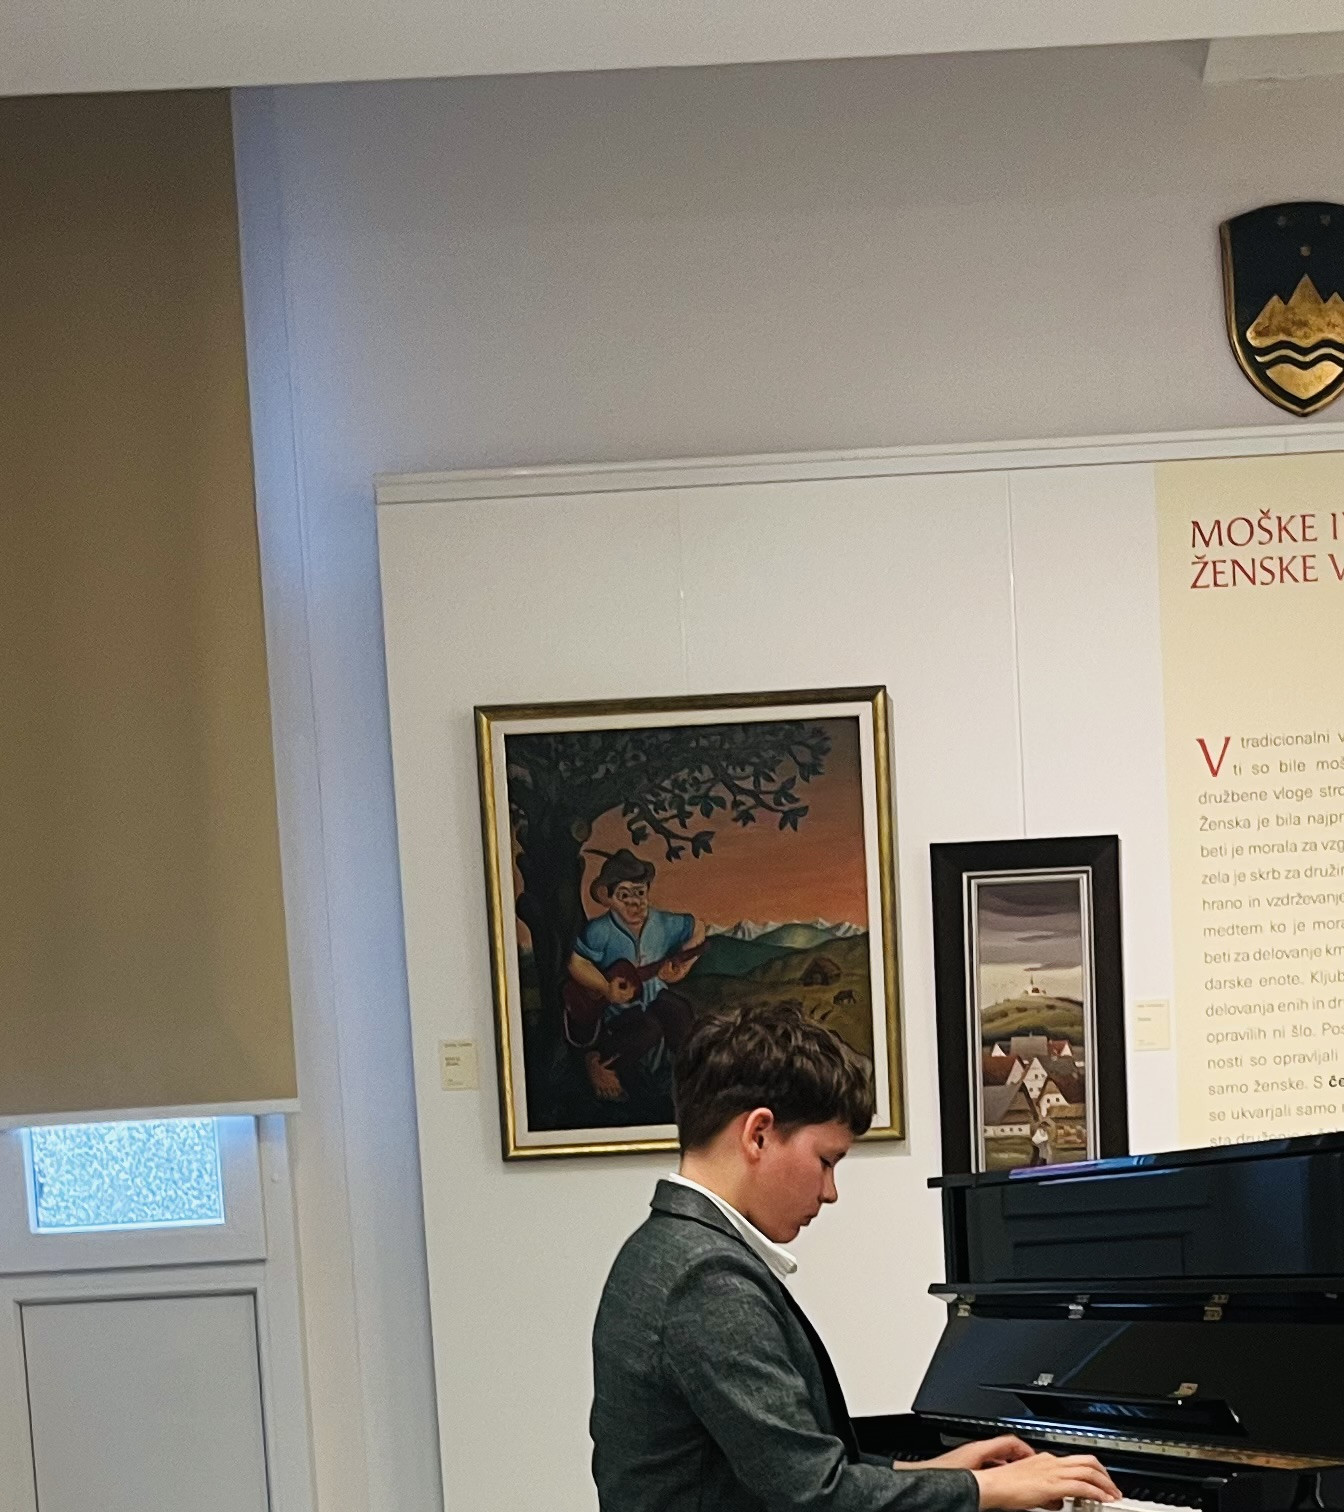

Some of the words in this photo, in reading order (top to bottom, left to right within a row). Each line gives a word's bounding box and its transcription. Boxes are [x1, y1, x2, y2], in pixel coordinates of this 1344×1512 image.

[1190, 508, 1318, 549] MOŠKE
[1190, 554, 1319, 590] ŽENSKE
[1195, 736, 1231, 778] V
[1240, 731, 1330, 749] tradicionalni
[1233, 762, 1242, 777] ti
[1251, 763, 1270, 775] so
[1279, 758, 1306, 774] bile
[1198, 788, 1268, 805] družbene
[1272, 785, 1313, 804] vloge
[1198, 815, 1252, 832] Ženska
[1256, 815, 1270, 832] je
[1275, 812, 1301, 828] bila
[1200, 842, 1227, 859] beti
[1230, 841, 1245, 858] je
[1248, 838, 1298, 856] morala
[1301, 839, 1318, 852] za
[1201, 869, 1230, 885] zela
[1233, 868, 1246, 886] je
[1249, 866, 1281, 882] skrb
[1284, 867, 1301, 879] za
[1202, 896, 1243, 911] hrano
[1248, 893, 1261, 908] in
[1203, 920, 1263, 938] medtem
[1269, 920, 1286, 934] ko
[1292, 919, 1306, 936] je
[1203, 949, 1231, 965] beti
[1233, 950, 1250, 963] za
[1252, 944, 1322, 963] delovanje
[1204, 974, 1253, 991] darske
[1205, 1000, 1275, 1019] delovanja
[1278, 997, 1309, 1013] enih
[1311, 996, 1325, 1011] in
[1206, 1025, 1267, 1045] opravilih
[1272, 1022, 1286, 1039] ni
[1207, 1053, 1243, 1071] nosti
[1249, 1055, 1268, 1068] so
[1272, 1046, 1339, 1067] opravljali
[1208, 1081, 1249, 1097] samo
[1312, 1075, 1324, 1091] S
[1209, 1109, 1226, 1123] se
[1230, 1103, 1293, 1122] ukvarjali
[1296, 1102, 1337, 1117] samo
